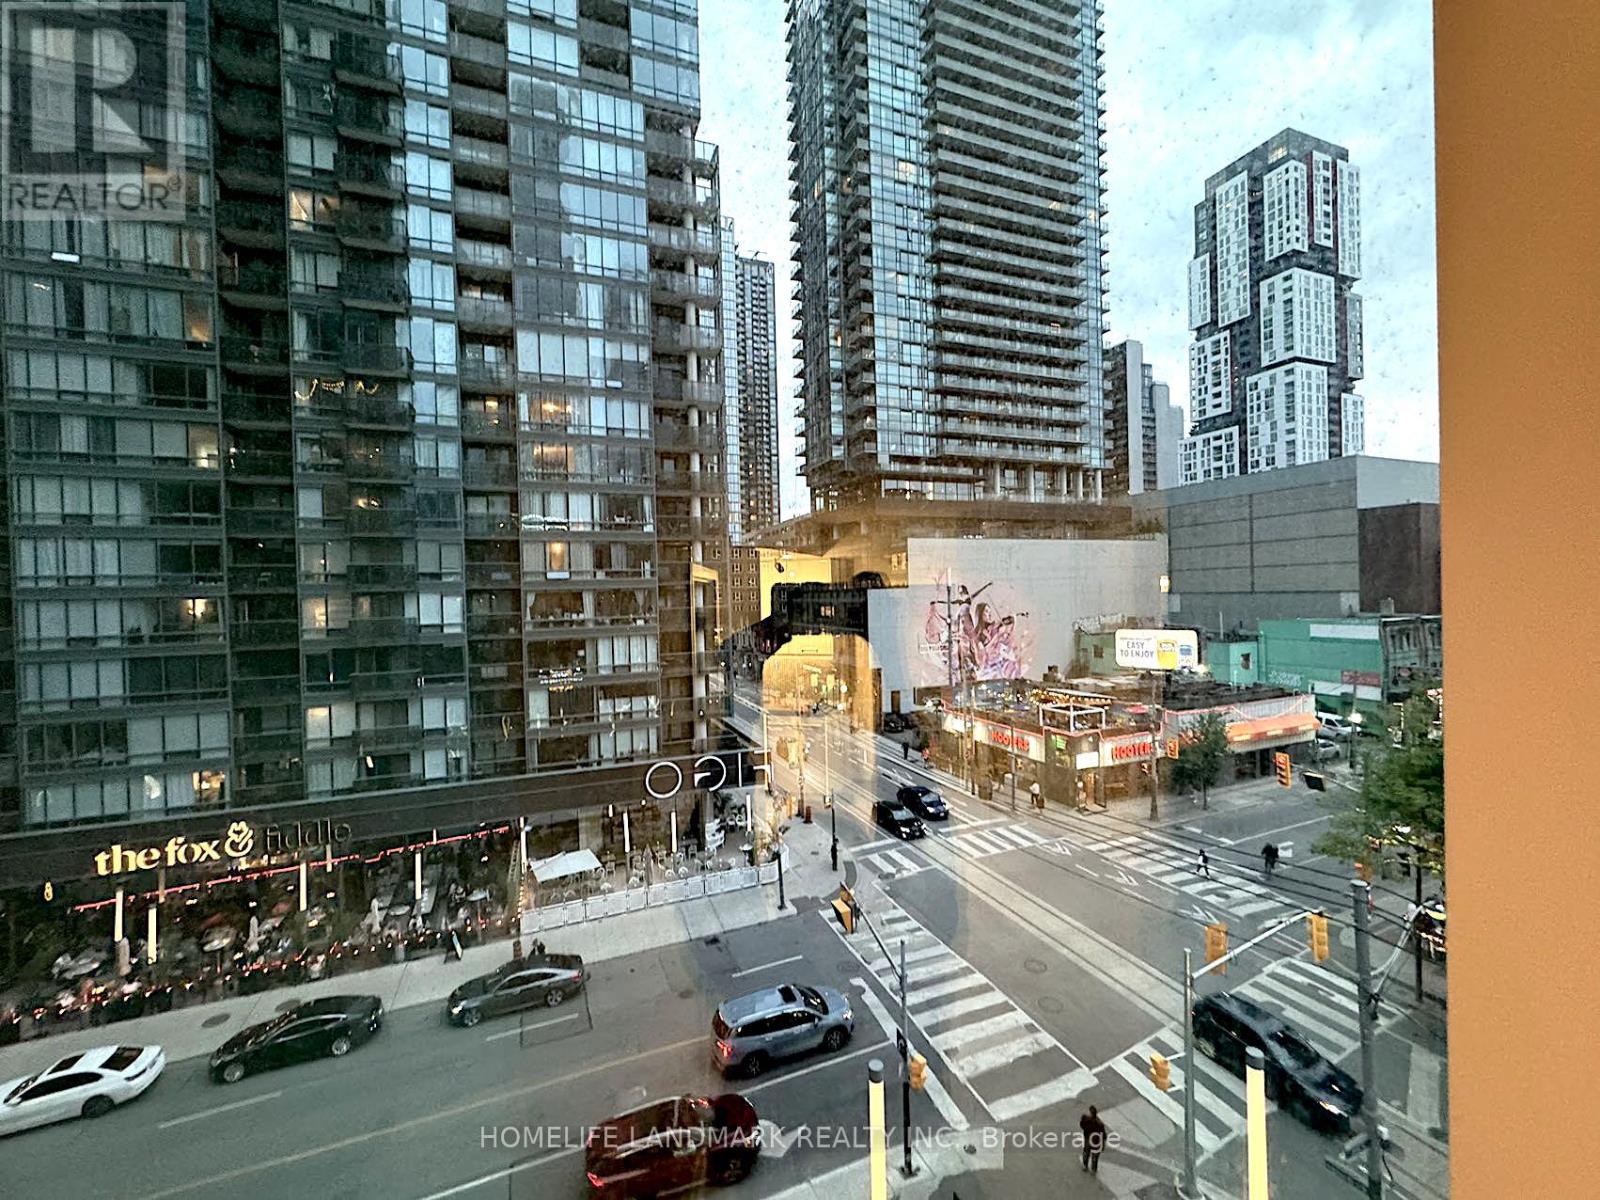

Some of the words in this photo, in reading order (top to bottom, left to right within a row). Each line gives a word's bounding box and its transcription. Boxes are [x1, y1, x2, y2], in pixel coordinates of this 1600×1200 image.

[1126, 641, 1145, 649] EASY
[1130, 650, 1155, 658] ENJOY
[94, 845, 159, 876] the
[165, 835, 221, 867] fox
